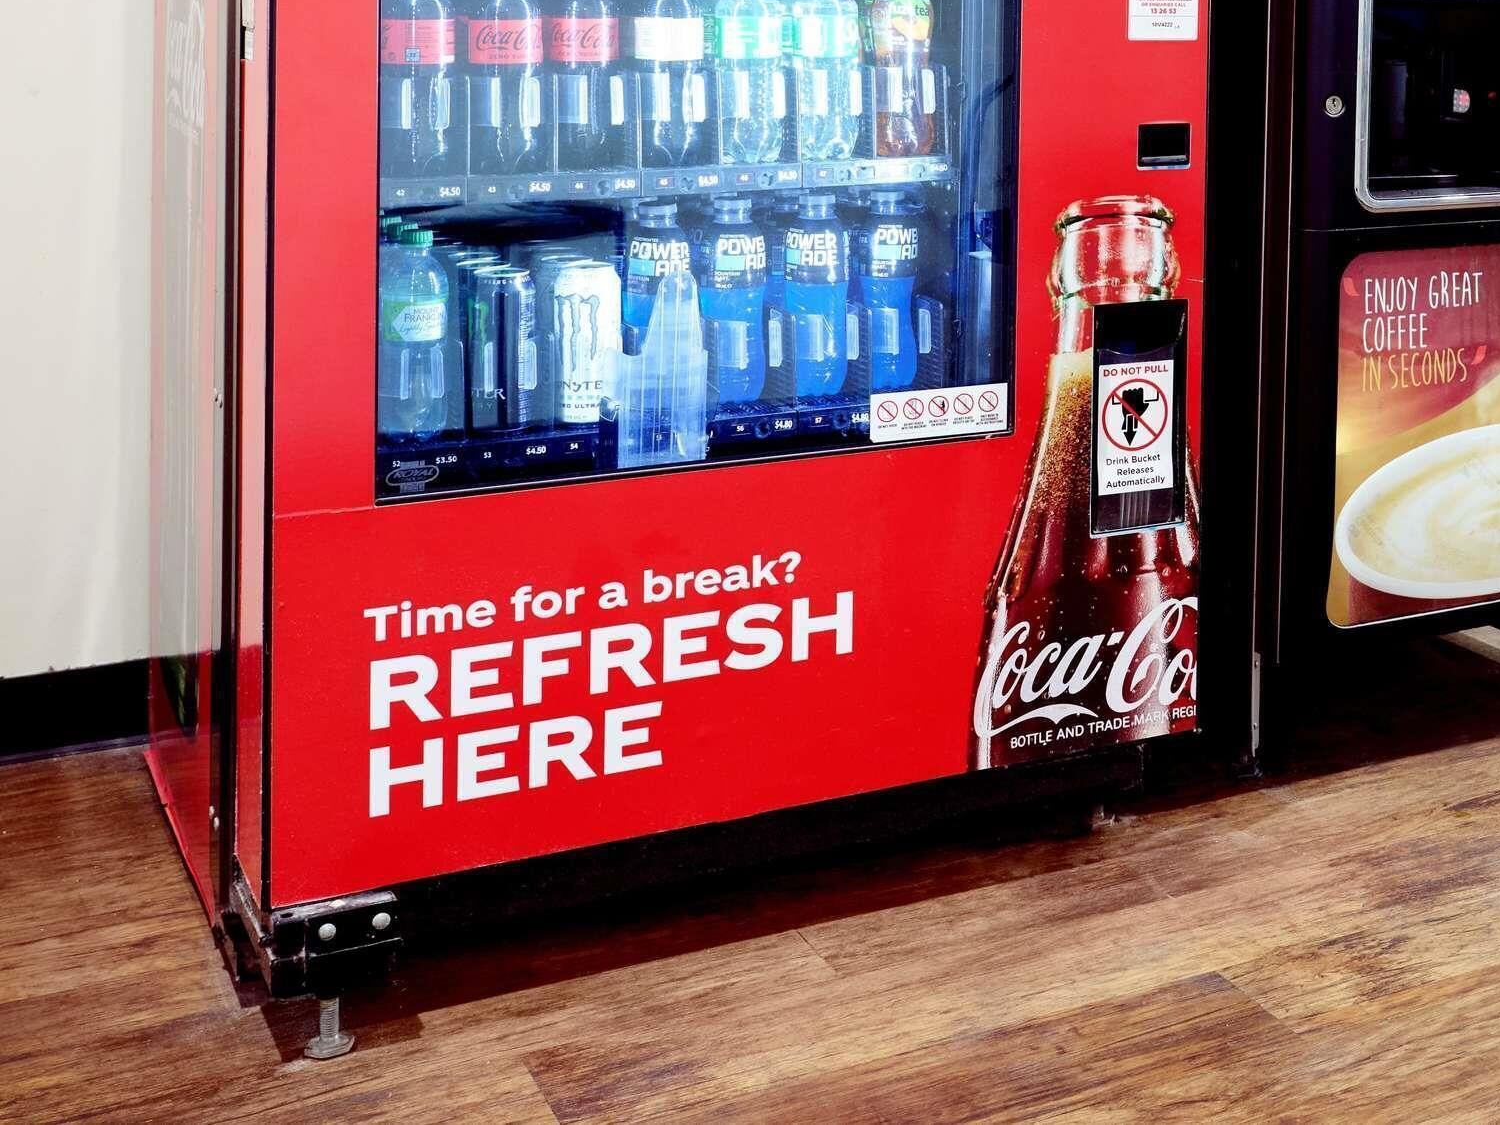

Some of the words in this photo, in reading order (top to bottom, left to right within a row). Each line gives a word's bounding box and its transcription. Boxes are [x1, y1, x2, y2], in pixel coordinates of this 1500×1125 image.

[914, 4, 930, 16] tea
[439, 187, 461, 197] $4.50
[529, 183, 551, 193] $4.50
[786, 229, 838, 251] POWER
[630, 240, 690, 261] POWER
[800, 248, 839, 267] ADE
[654, 258, 690, 277] ADE
[1364, 276, 1418, 315] ENJOY
[1428, 271, 1483, 309] GREAT
[1363, 313, 1428, 354] COFFEE
[1103, 368, 1118, 377] DO
[1121, 366, 1142, 376] NOT
[1144, 364, 1169, 373] PULL
[1361, 355, 1382, 392] IN
[1388, 347, 1468, 389] SECONDS
[526, 445, 547, 455] $4.50
[570, 442, 578, 450] 54
[435, 455, 458, 464] $3.50
[483, 451, 492, 459] 53
[1106, 456, 1129, 466] Drink
[1131, 453, 1161, 463] Bucket
[393, 468, 434, 479] ROYAL
[1116, 466, 1154, 476] Releases
[1106, 475, 1166, 489] Automatically
[364, 599, 497, 642] Time
[510, 584, 585, 622] for
[598, 581, 629, 610] a
[643, 551, 802, 604] break?
[369, 591, 854, 732] REFRESH
[973, 597, 1198, 739] Coca-Co
[1010, 730, 1053, 749] BOTTLE
[1056, 725, 1085, 740] AND
[1088, 718, 1130, 734] TRADE
[1134, 711, 1169, 725] MARK
[369, 701, 664, 819] HERE
